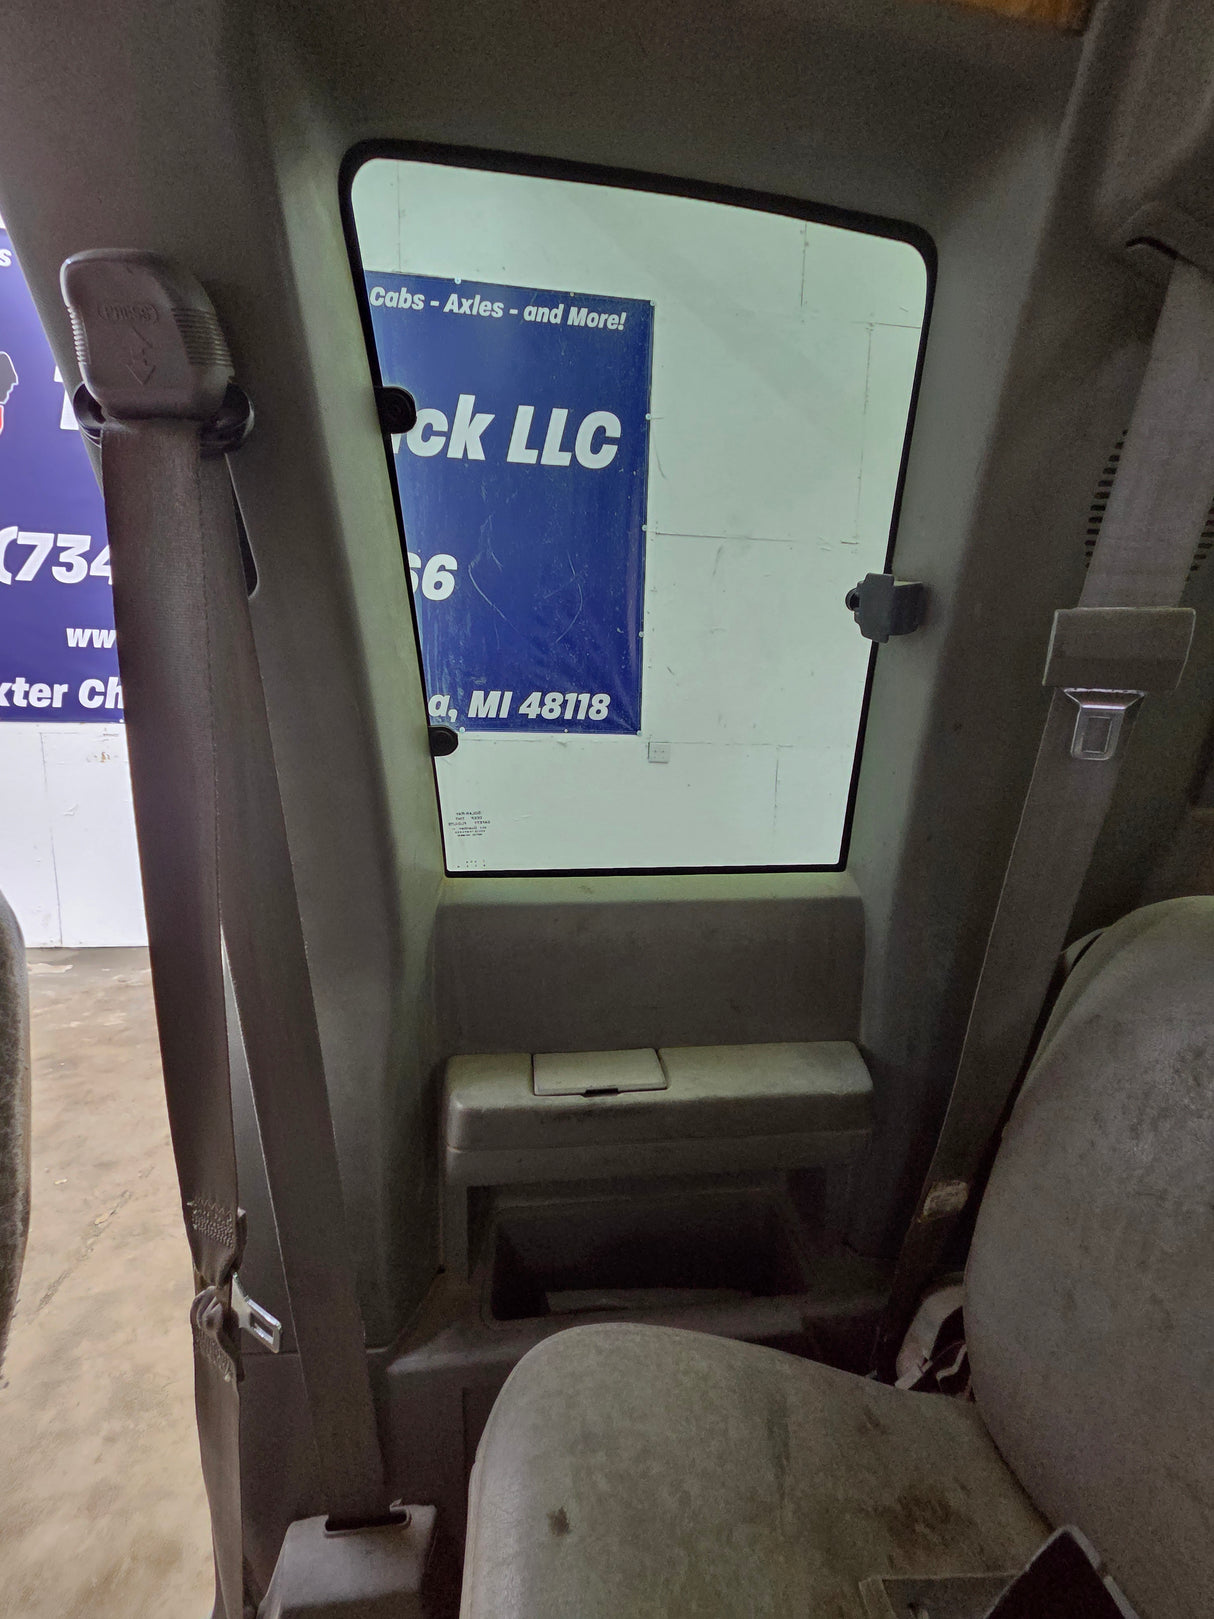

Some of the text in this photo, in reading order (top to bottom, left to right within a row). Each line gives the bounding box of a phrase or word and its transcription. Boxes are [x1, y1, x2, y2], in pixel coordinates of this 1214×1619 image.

[369, 286, 425, 310] Cabs
[443, 293, 504, 318] Axles
[523, 303, 564, 325] and
[567, 307, 627, 331] More!
[391, 393, 622, 470] ck LLC
[467, 690, 513, 719] MI
[518, 691, 611, 721] 48118
